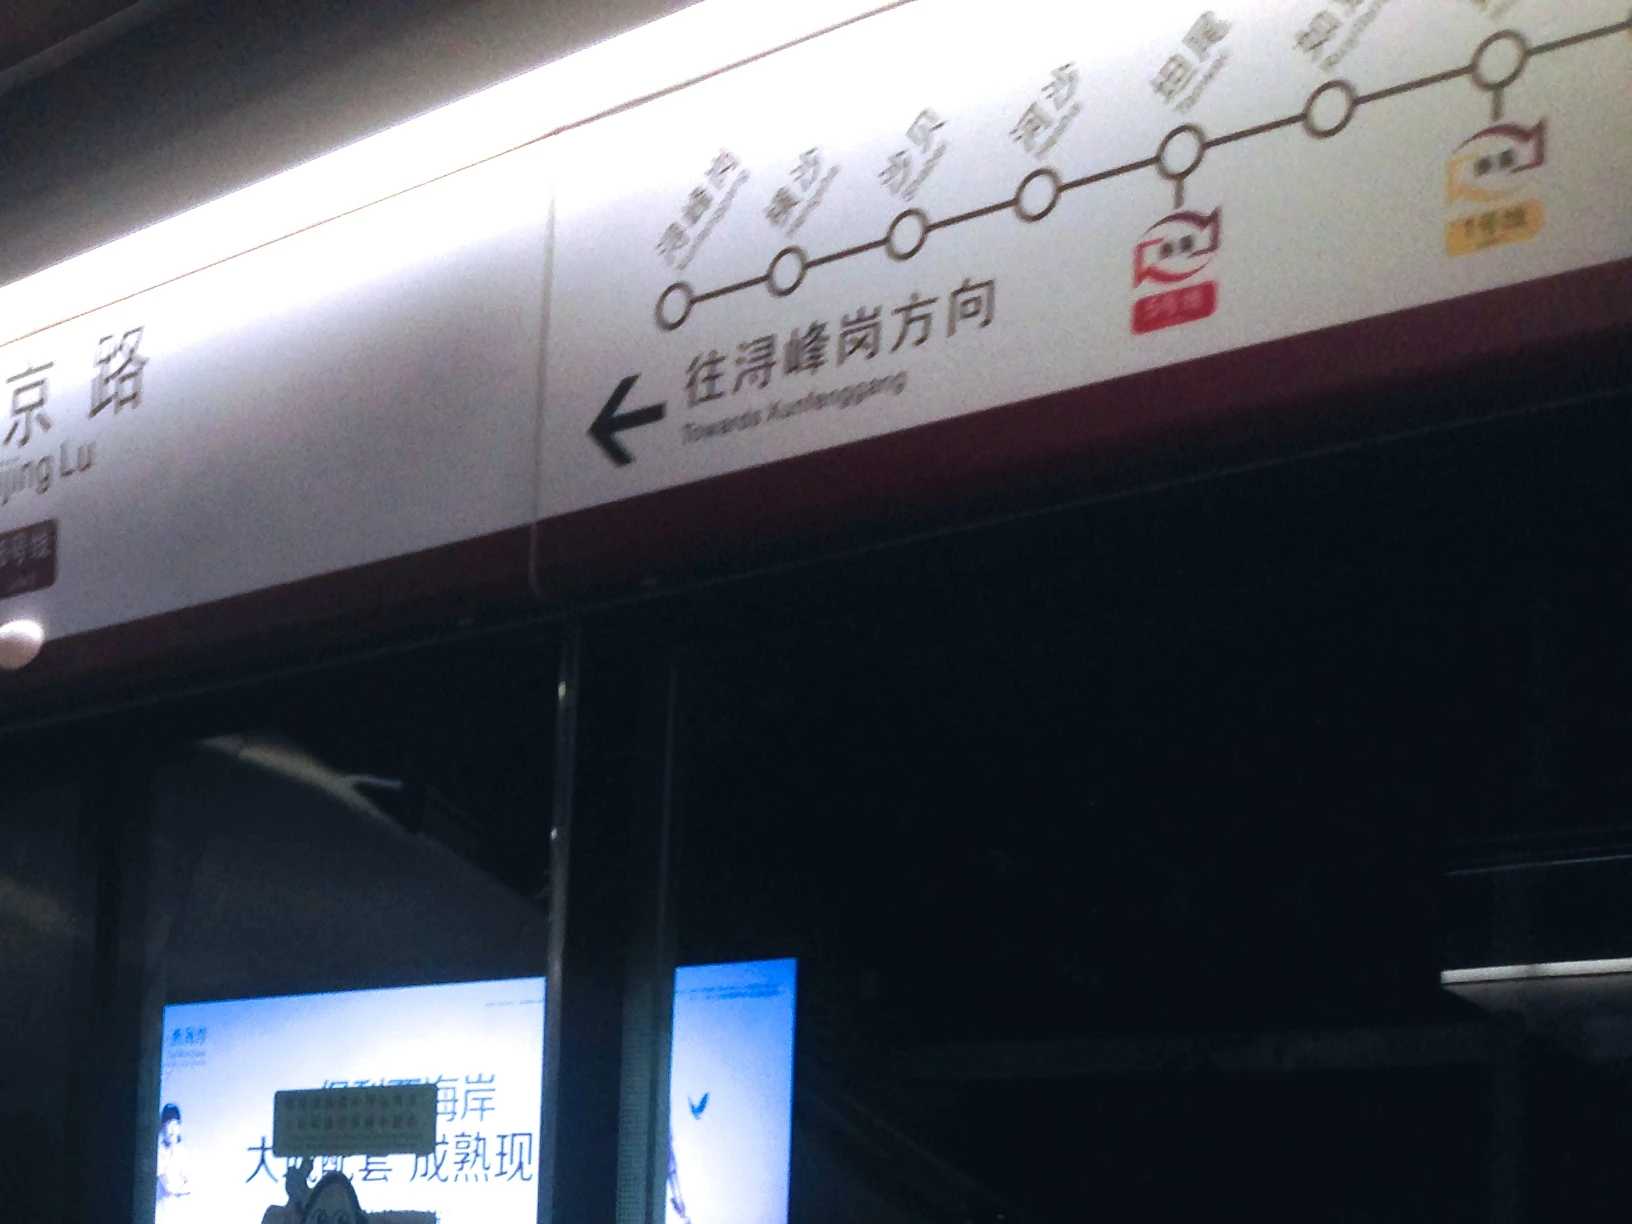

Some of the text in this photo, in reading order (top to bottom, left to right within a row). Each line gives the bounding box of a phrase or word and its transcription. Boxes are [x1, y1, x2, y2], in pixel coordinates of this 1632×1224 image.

[684, 278, 997, 408] 往浔峰岗方向
[60, 440, 96, 478] Lu
